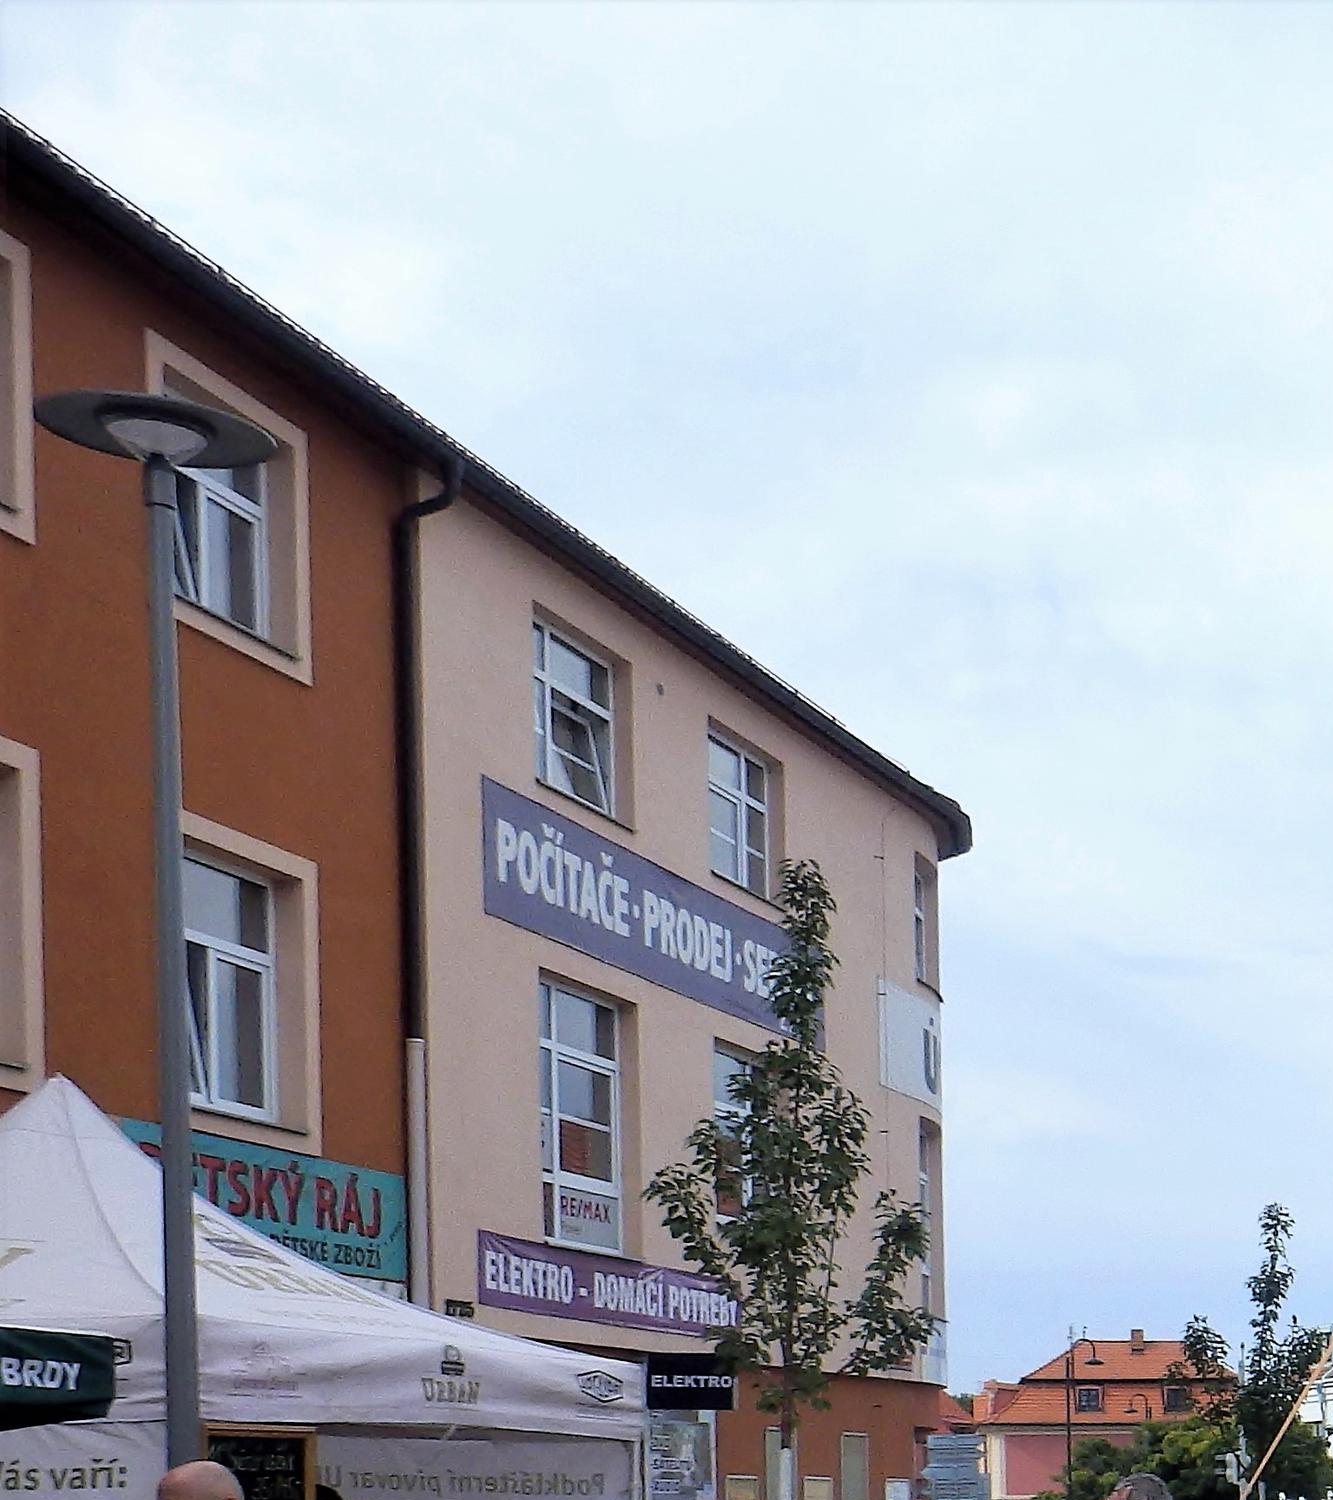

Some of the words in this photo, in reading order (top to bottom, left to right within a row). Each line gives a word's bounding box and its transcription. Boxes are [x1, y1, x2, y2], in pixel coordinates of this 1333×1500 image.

[497, 817, 631, 938] POČÍTAČE
[642, 888, 733, 984] PRODEJ
[314, 1172, 382, 1239] RÁJ
[560, 1195, 611, 1225] RE/MAX
[484, 1250, 574, 1304] ELEKTRO
[1, 1356, 82, 1391] BRDY
[421, 1377, 480, 1403] URBAN
[651, 1375, 733, 1388] ELEKTRO
[0, 1458, 40, 1491] ás
